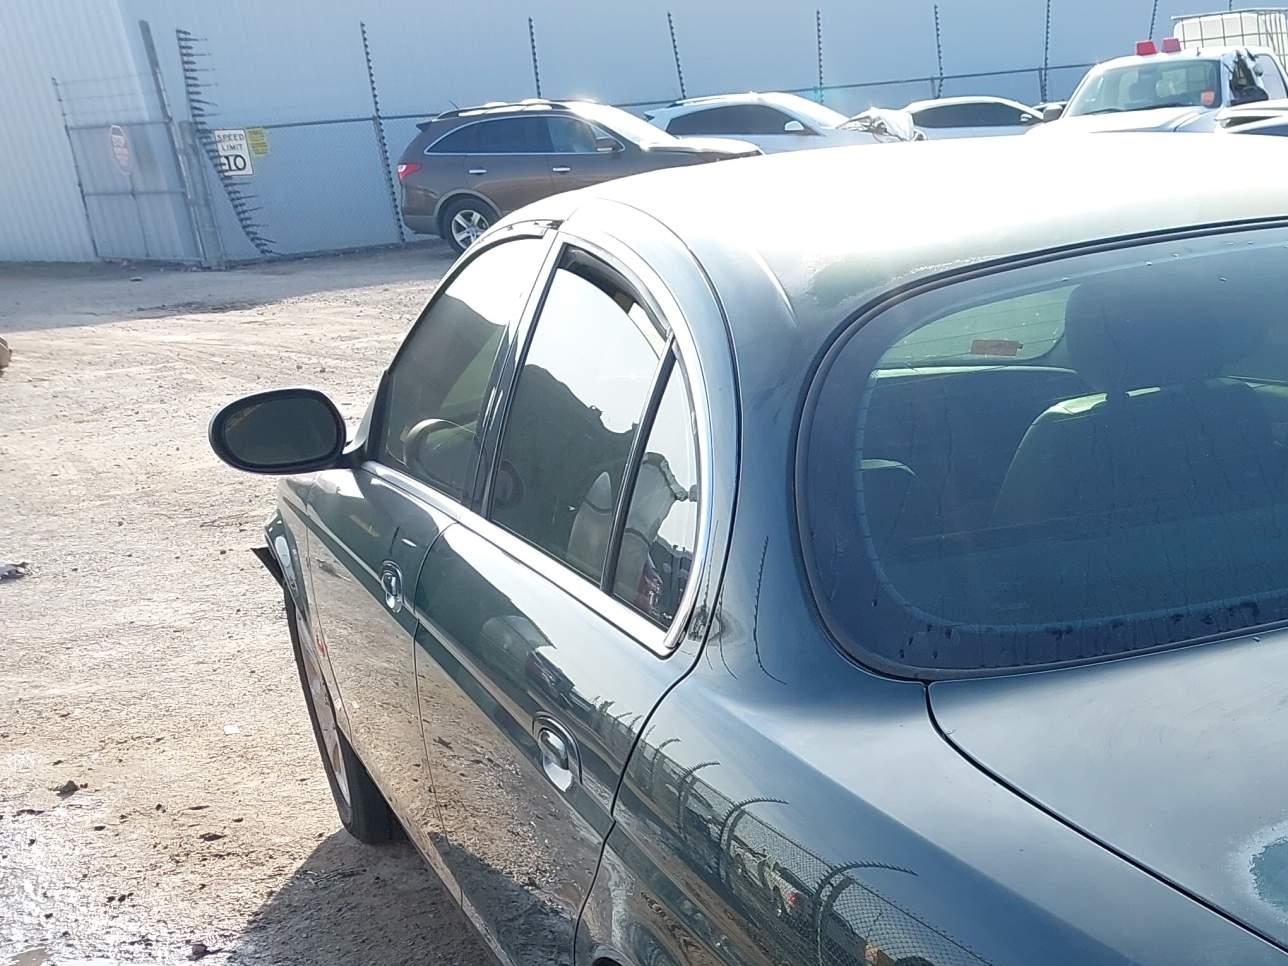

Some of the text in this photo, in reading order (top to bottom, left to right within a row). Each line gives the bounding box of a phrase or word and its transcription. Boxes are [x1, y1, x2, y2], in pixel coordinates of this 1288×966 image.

[217, 133, 245, 143] SPEED
[221, 143, 243, 152] LIMIT
[223, 154, 247, 172] 10
